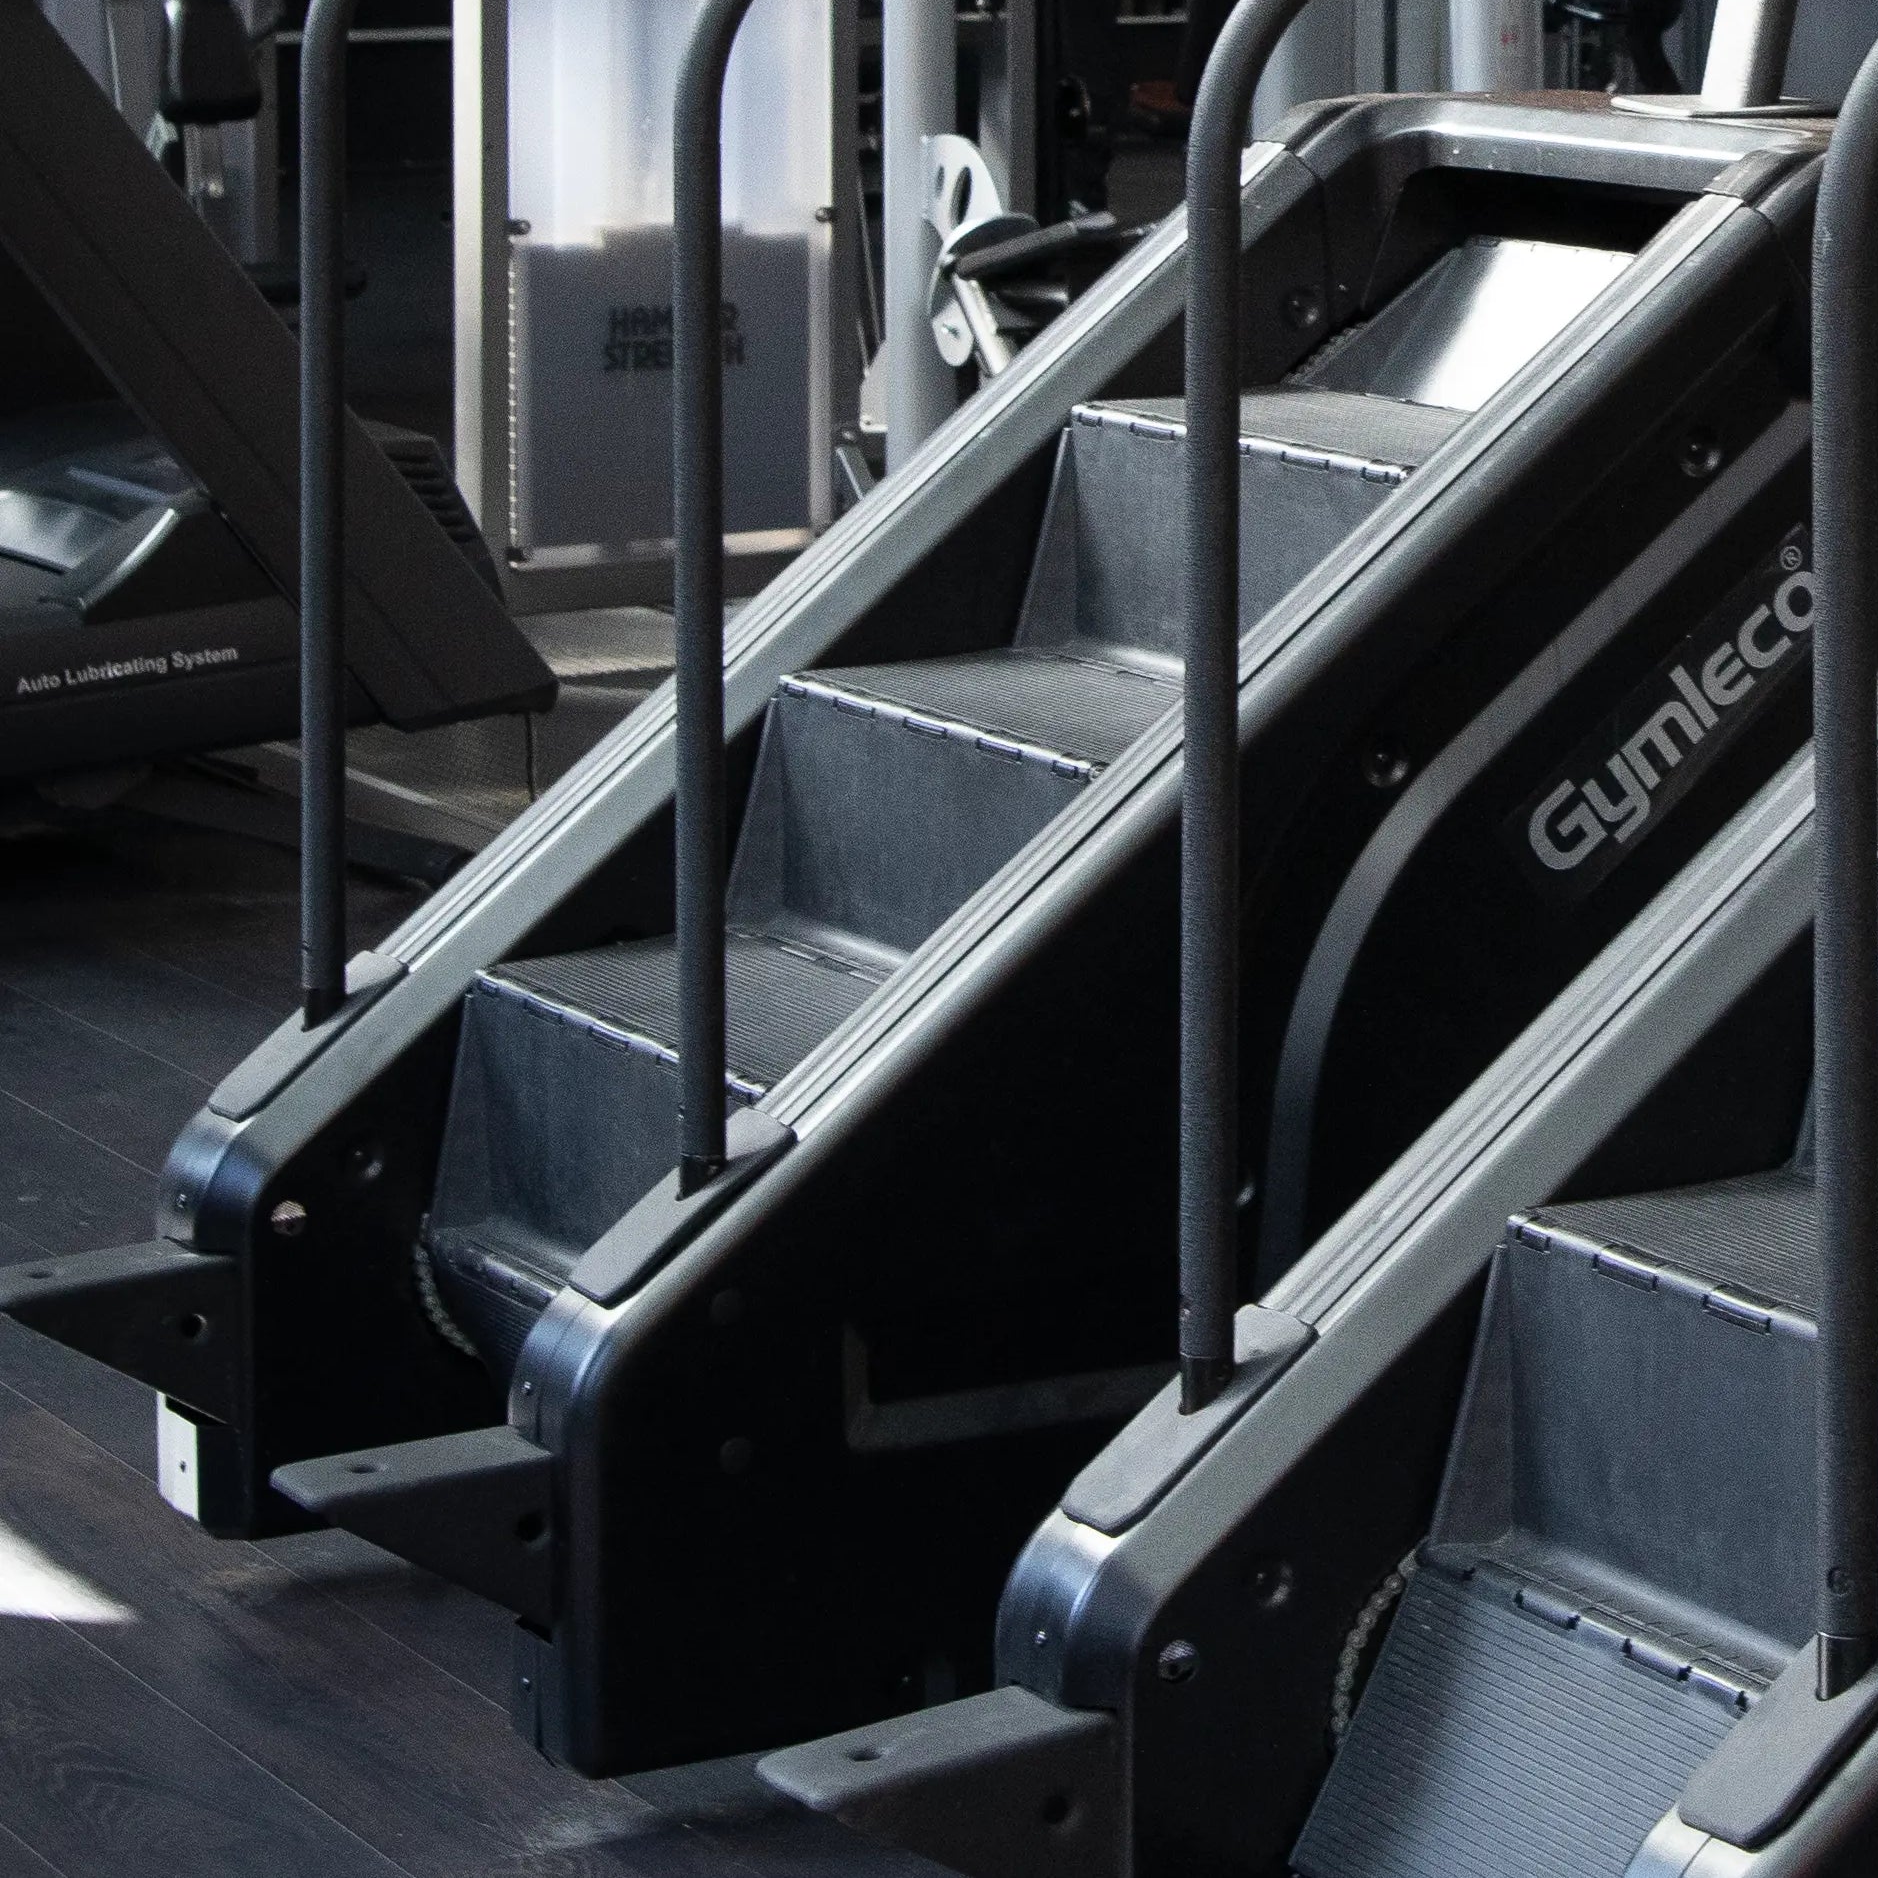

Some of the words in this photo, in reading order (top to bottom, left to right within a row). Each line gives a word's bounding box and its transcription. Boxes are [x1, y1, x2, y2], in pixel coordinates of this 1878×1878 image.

[609, 303, 740, 336] HAMR
[603, 334, 746, 373] STREH
[16, 675, 62, 695] Auto
[64, 655, 169, 686] Lubricating
[171, 646, 239, 672] System
